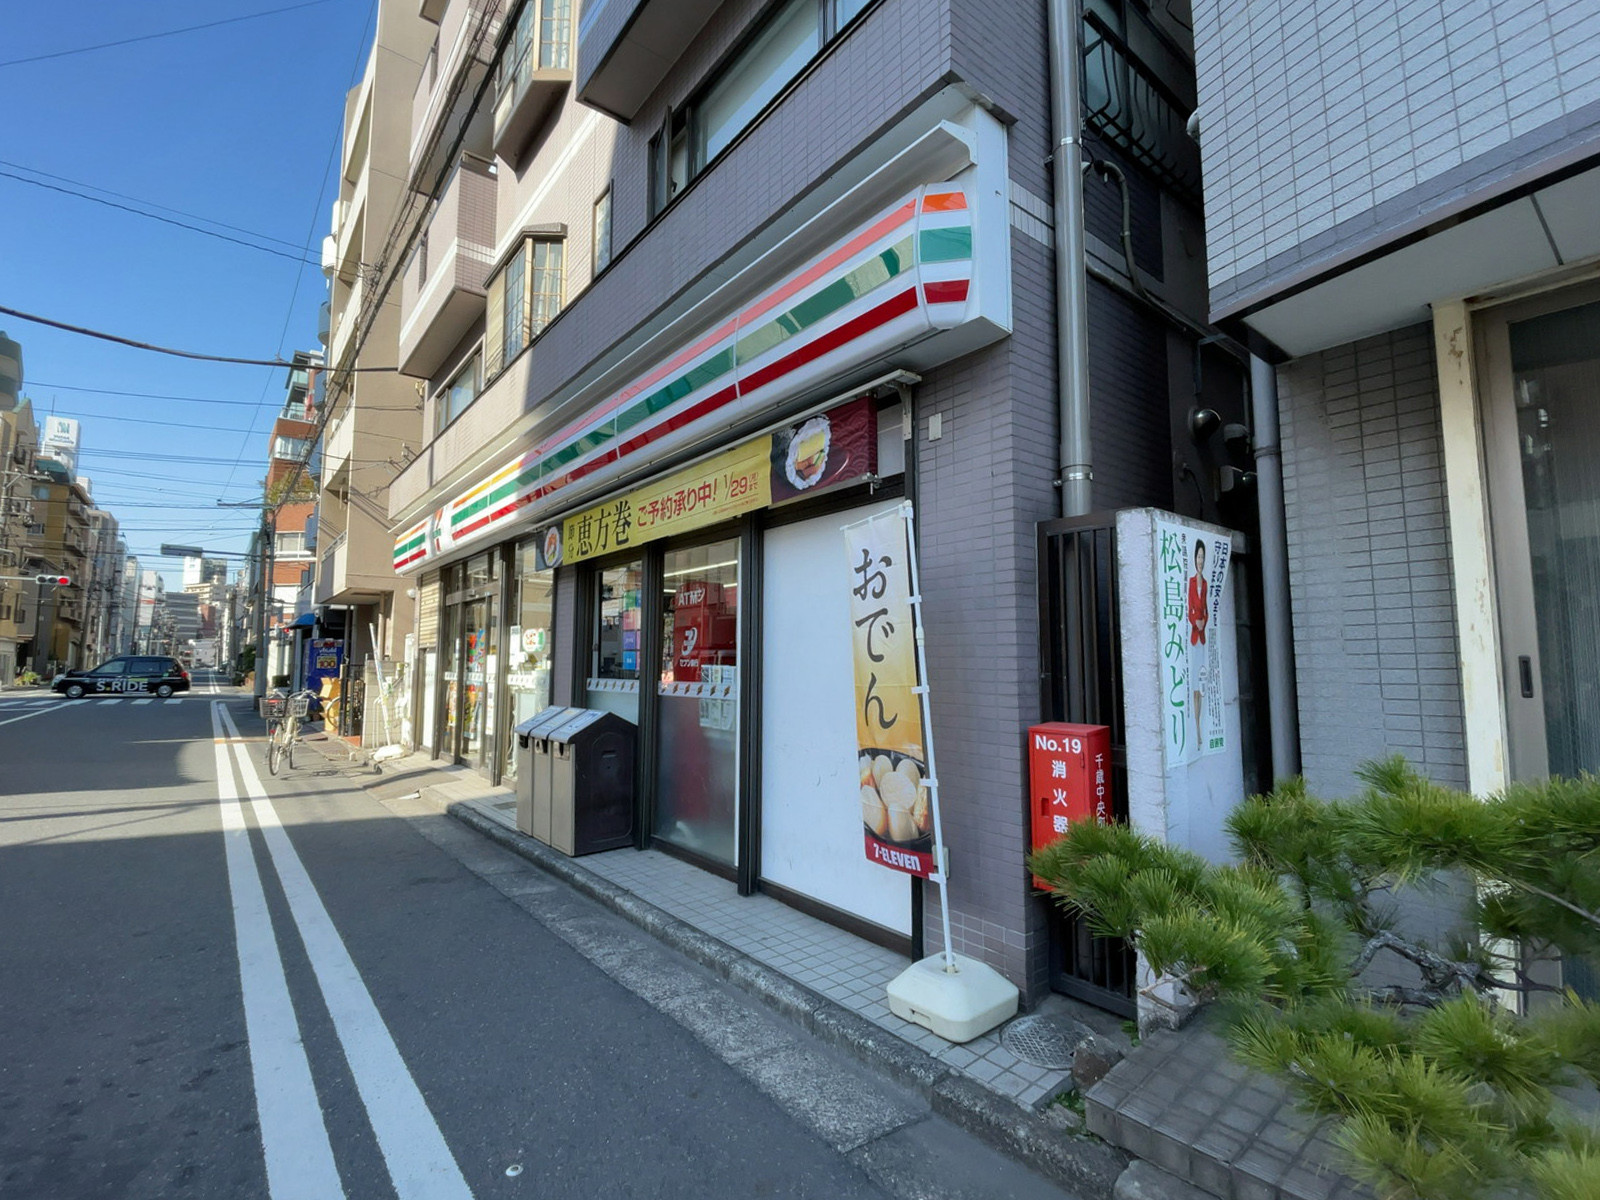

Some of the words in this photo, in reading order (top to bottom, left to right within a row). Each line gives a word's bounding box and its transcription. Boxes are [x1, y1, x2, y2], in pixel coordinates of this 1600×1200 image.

[576, 499, 632, 557] 恵方巻
[637, 477, 718, 528] ご予約承り中!
[723, 471, 749, 502] 1/29
[678, 590, 699, 607] ATM
[852, 547, 898, 730] おでん
[1160, 528, 1187, 757] 松島みどり
[1035, 734, 1082, 755] No.19
[1051, 759, 1069, 834] 消火器
